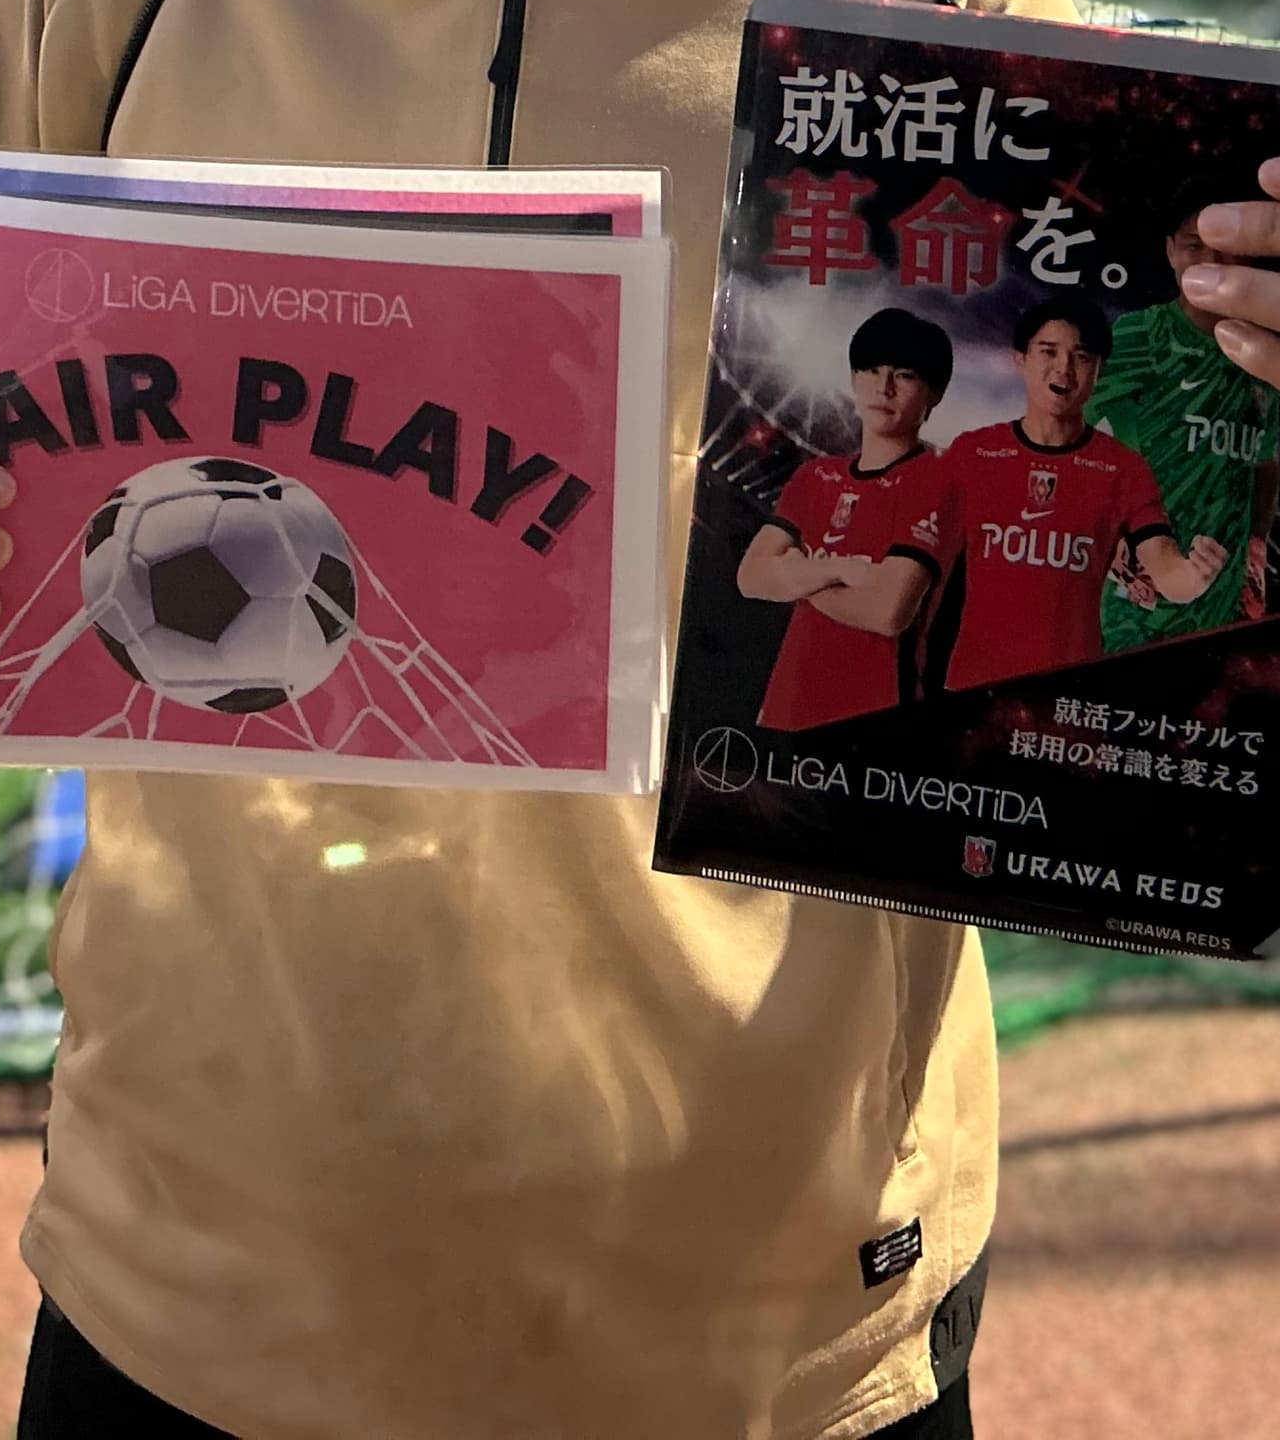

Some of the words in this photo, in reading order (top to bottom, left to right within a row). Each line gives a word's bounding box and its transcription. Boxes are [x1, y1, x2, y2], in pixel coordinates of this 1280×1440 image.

[775, 66, 1051, 164] 就活に
[762, 167, 1128, 296] 革命を。
[232, 356, 598, 556] PLAY!
[980, 523, 1095, 573] POLUS
[1053, 696, 1265, 756] 就活フットサルで
[1009, 728, 1260, 796] 採用の常識を変える
[1006, 851, 1121, 893] URAWA
[1135, 873, 1224, 909] REDS
[1186, 931, 1232, 951] REDS
